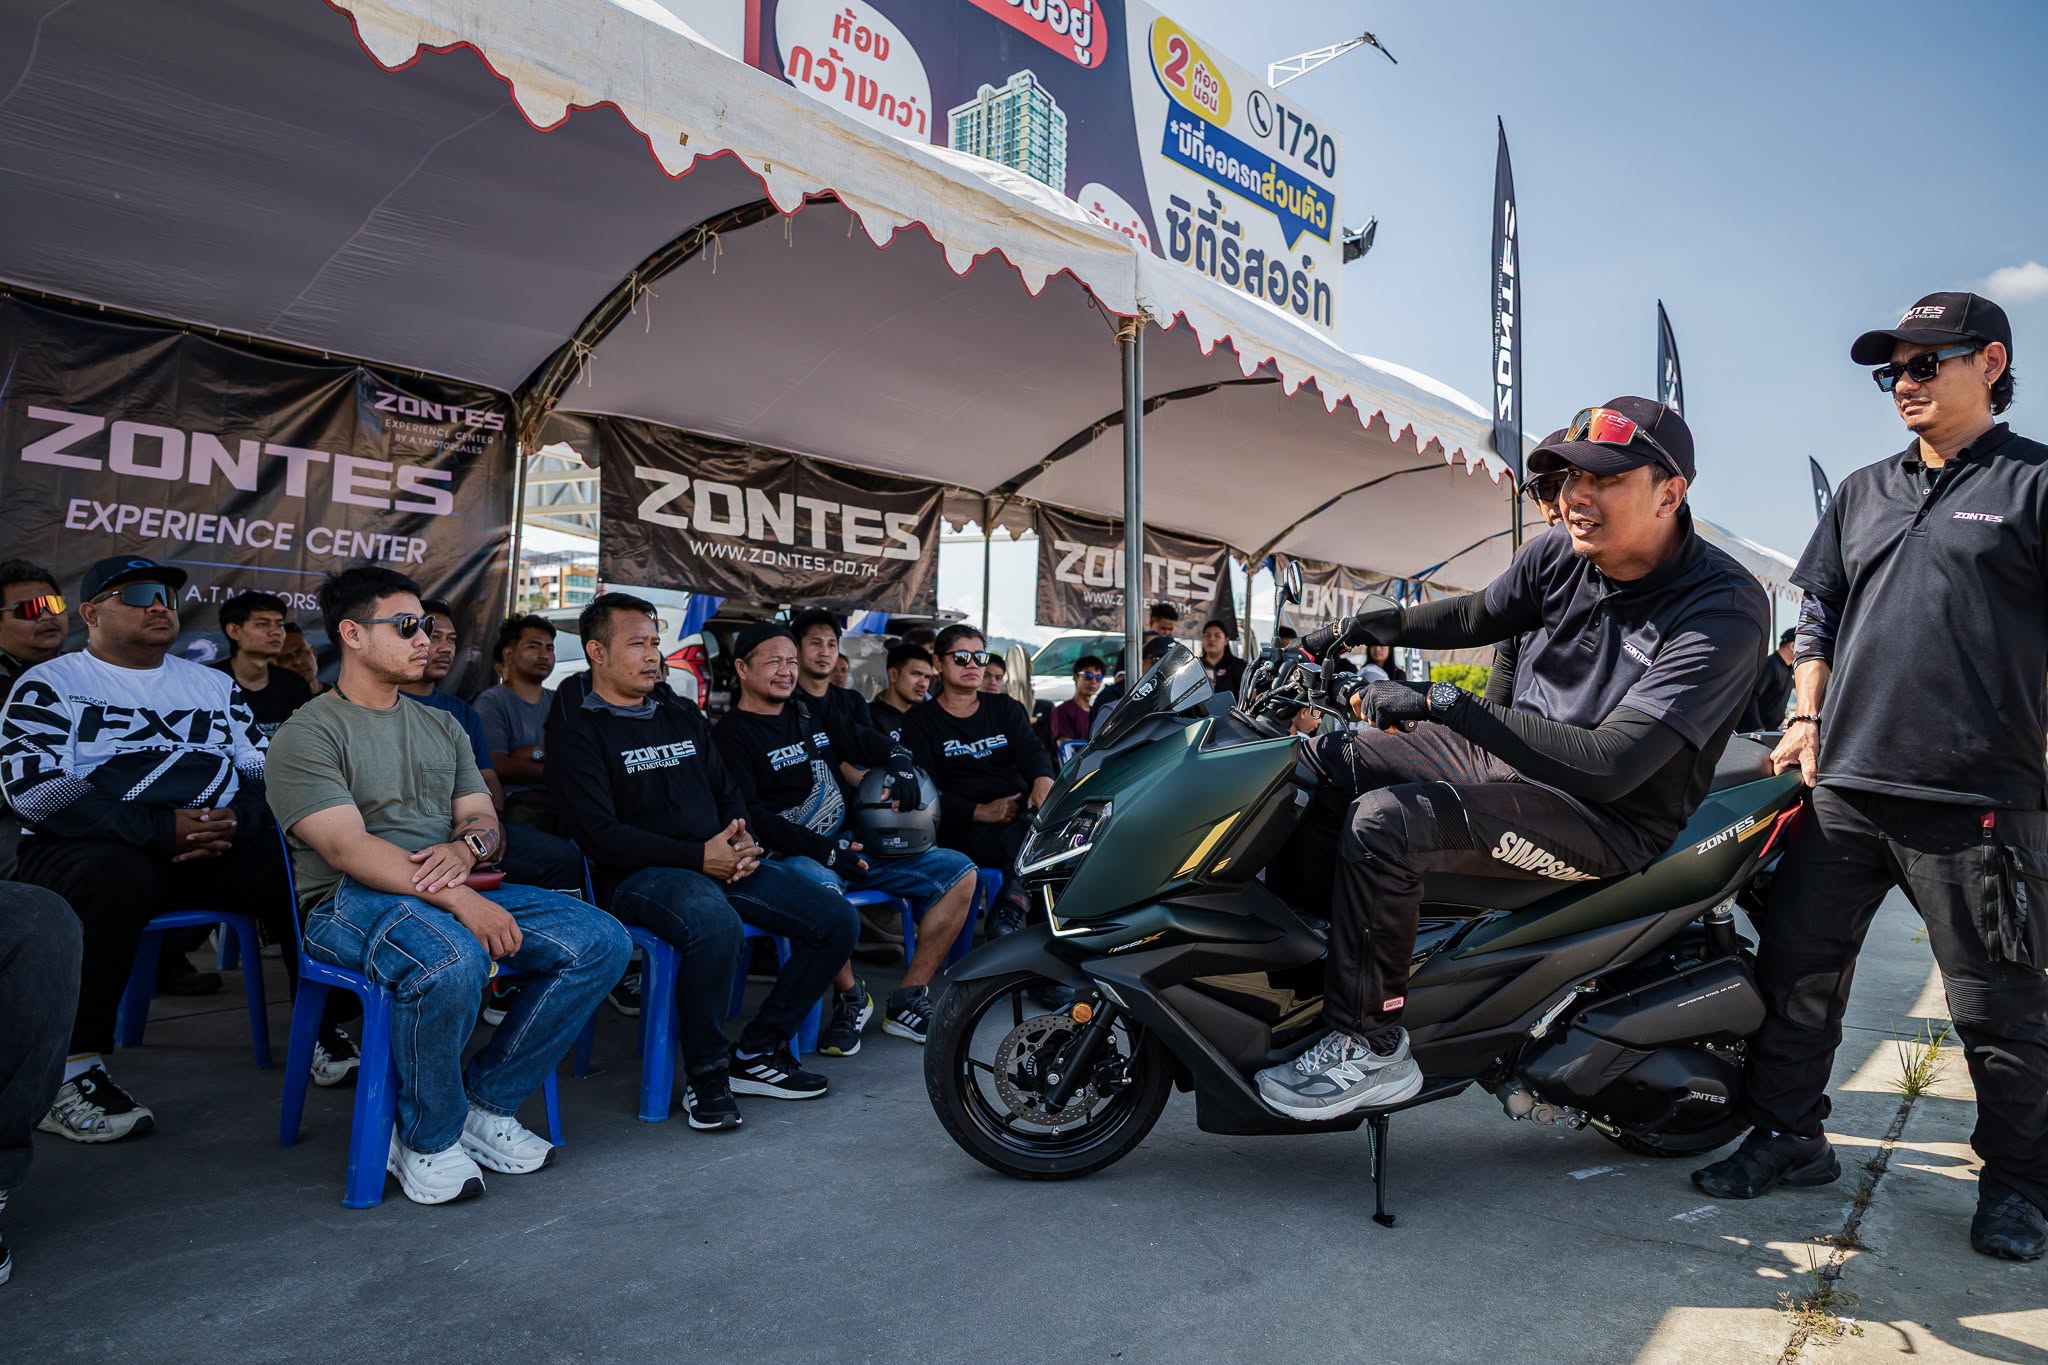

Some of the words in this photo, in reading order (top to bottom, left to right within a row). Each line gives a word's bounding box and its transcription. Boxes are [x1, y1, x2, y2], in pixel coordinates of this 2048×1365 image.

[832, 8, 890, 61] ห้อง
[1164, 37, 1189, 88] 2
[1194, 64, 1218, 94] ห้อง
[788, 45, 926, 135] กว้างกว่า
[1193, 84, 1218, 112] นอน
[1276, 103, 1336, 179] 1720
[374, 391, 505, 431] ZONTES
[385, 419, 450, 438] EXPERIENCE
[455, 432, 494, 445] CENTER
[395, 434, 407, 442] BY
[21, 405, 454, 517] ZONTES
[65, 498, 295, 552] EXPERIENCE
[305, 525, 428, 564] CENTER
[635, 465, 921, 561] ZONTES
[1953, 511, 2004, 523] ZONTES
[690, 540, 878, 577] WWW.ZONTES.CO.TH
[1054, 540, 1218, 601] ZOTES
[1622, 641, 1654, 667] ZONTES
[621, 740, 696, 765] ZONTES
[1696, 815, 1755, 855] ZONTES
[1690, 1091, 1726, 1104] ONTES
